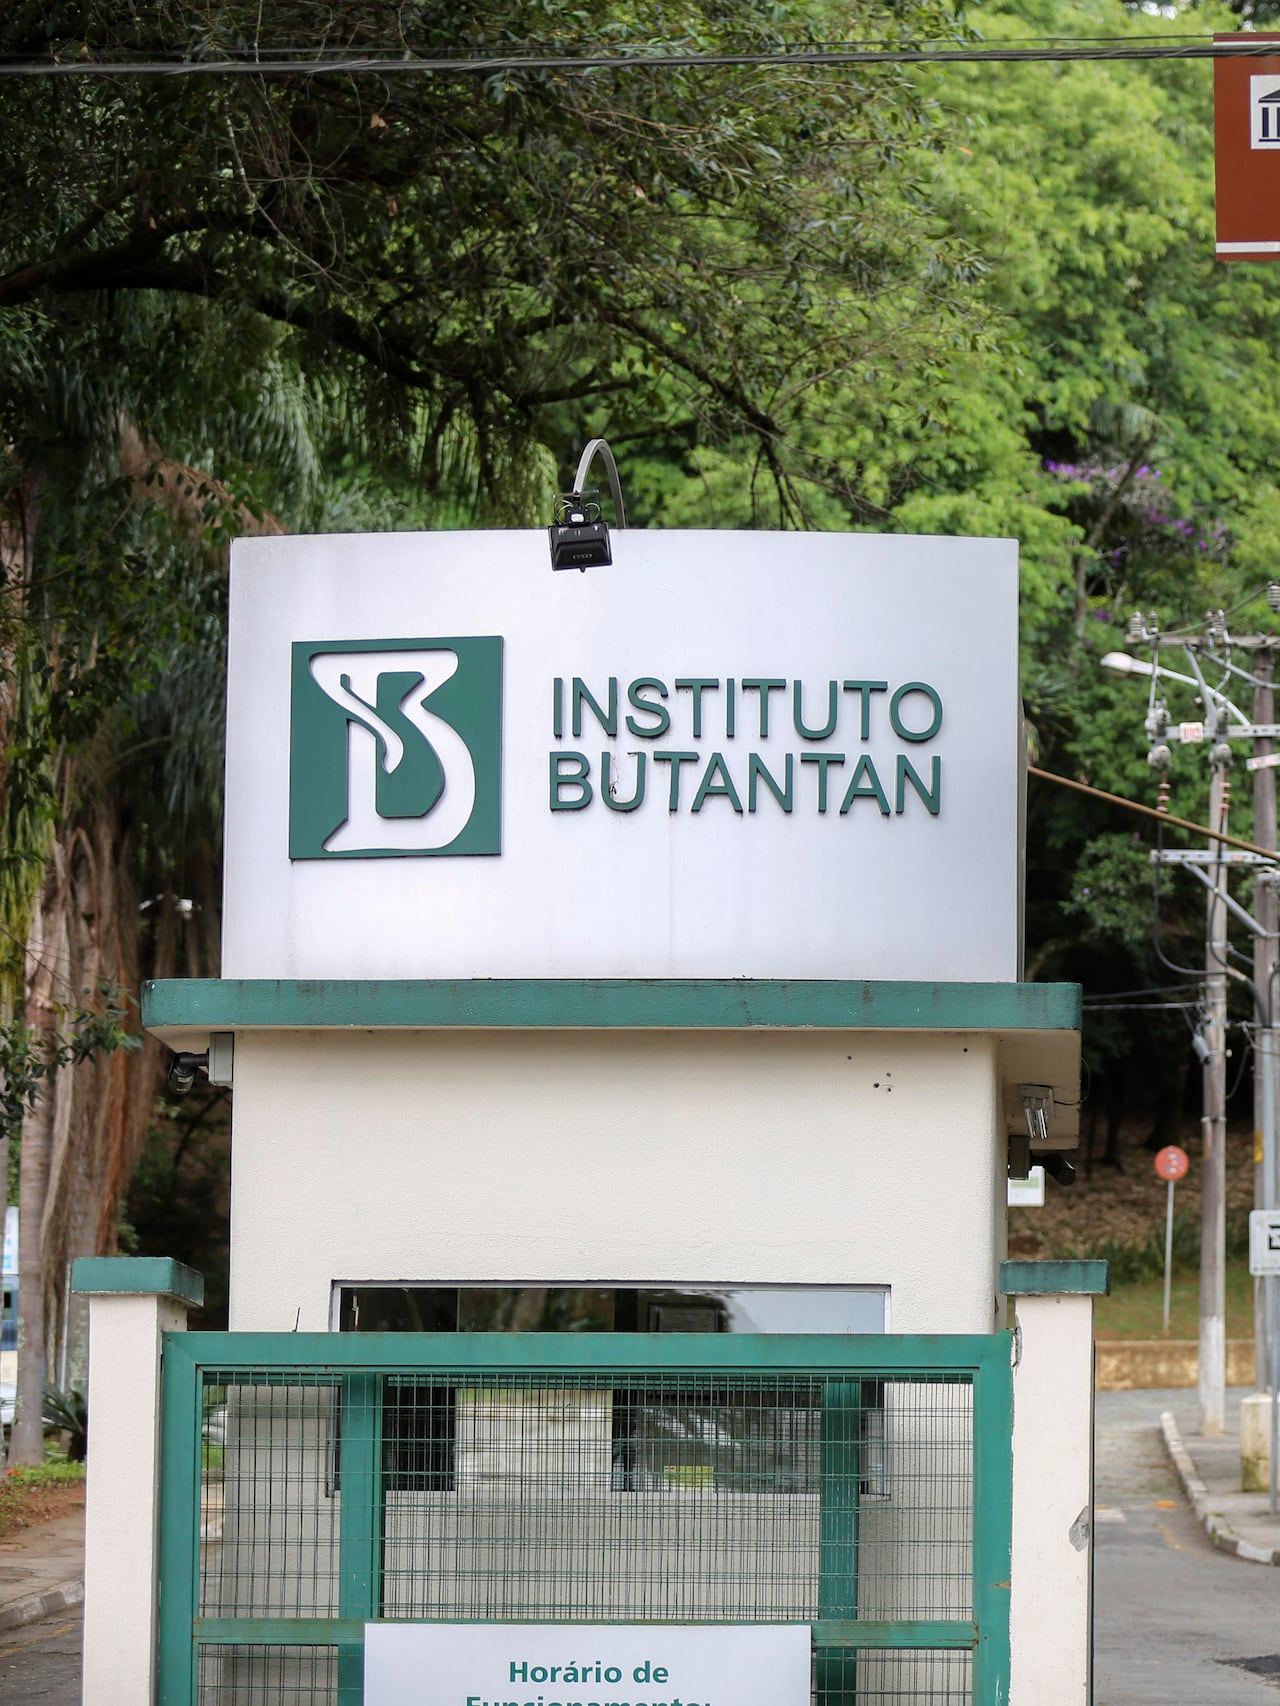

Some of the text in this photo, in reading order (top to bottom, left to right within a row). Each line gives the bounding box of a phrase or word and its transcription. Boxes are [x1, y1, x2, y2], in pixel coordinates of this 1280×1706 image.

[553, 677, 943, 743] INSTITUTO
[549, 750, 941, 817] BUTANTAN
[509, 1660, 669, 1684] Horário de
